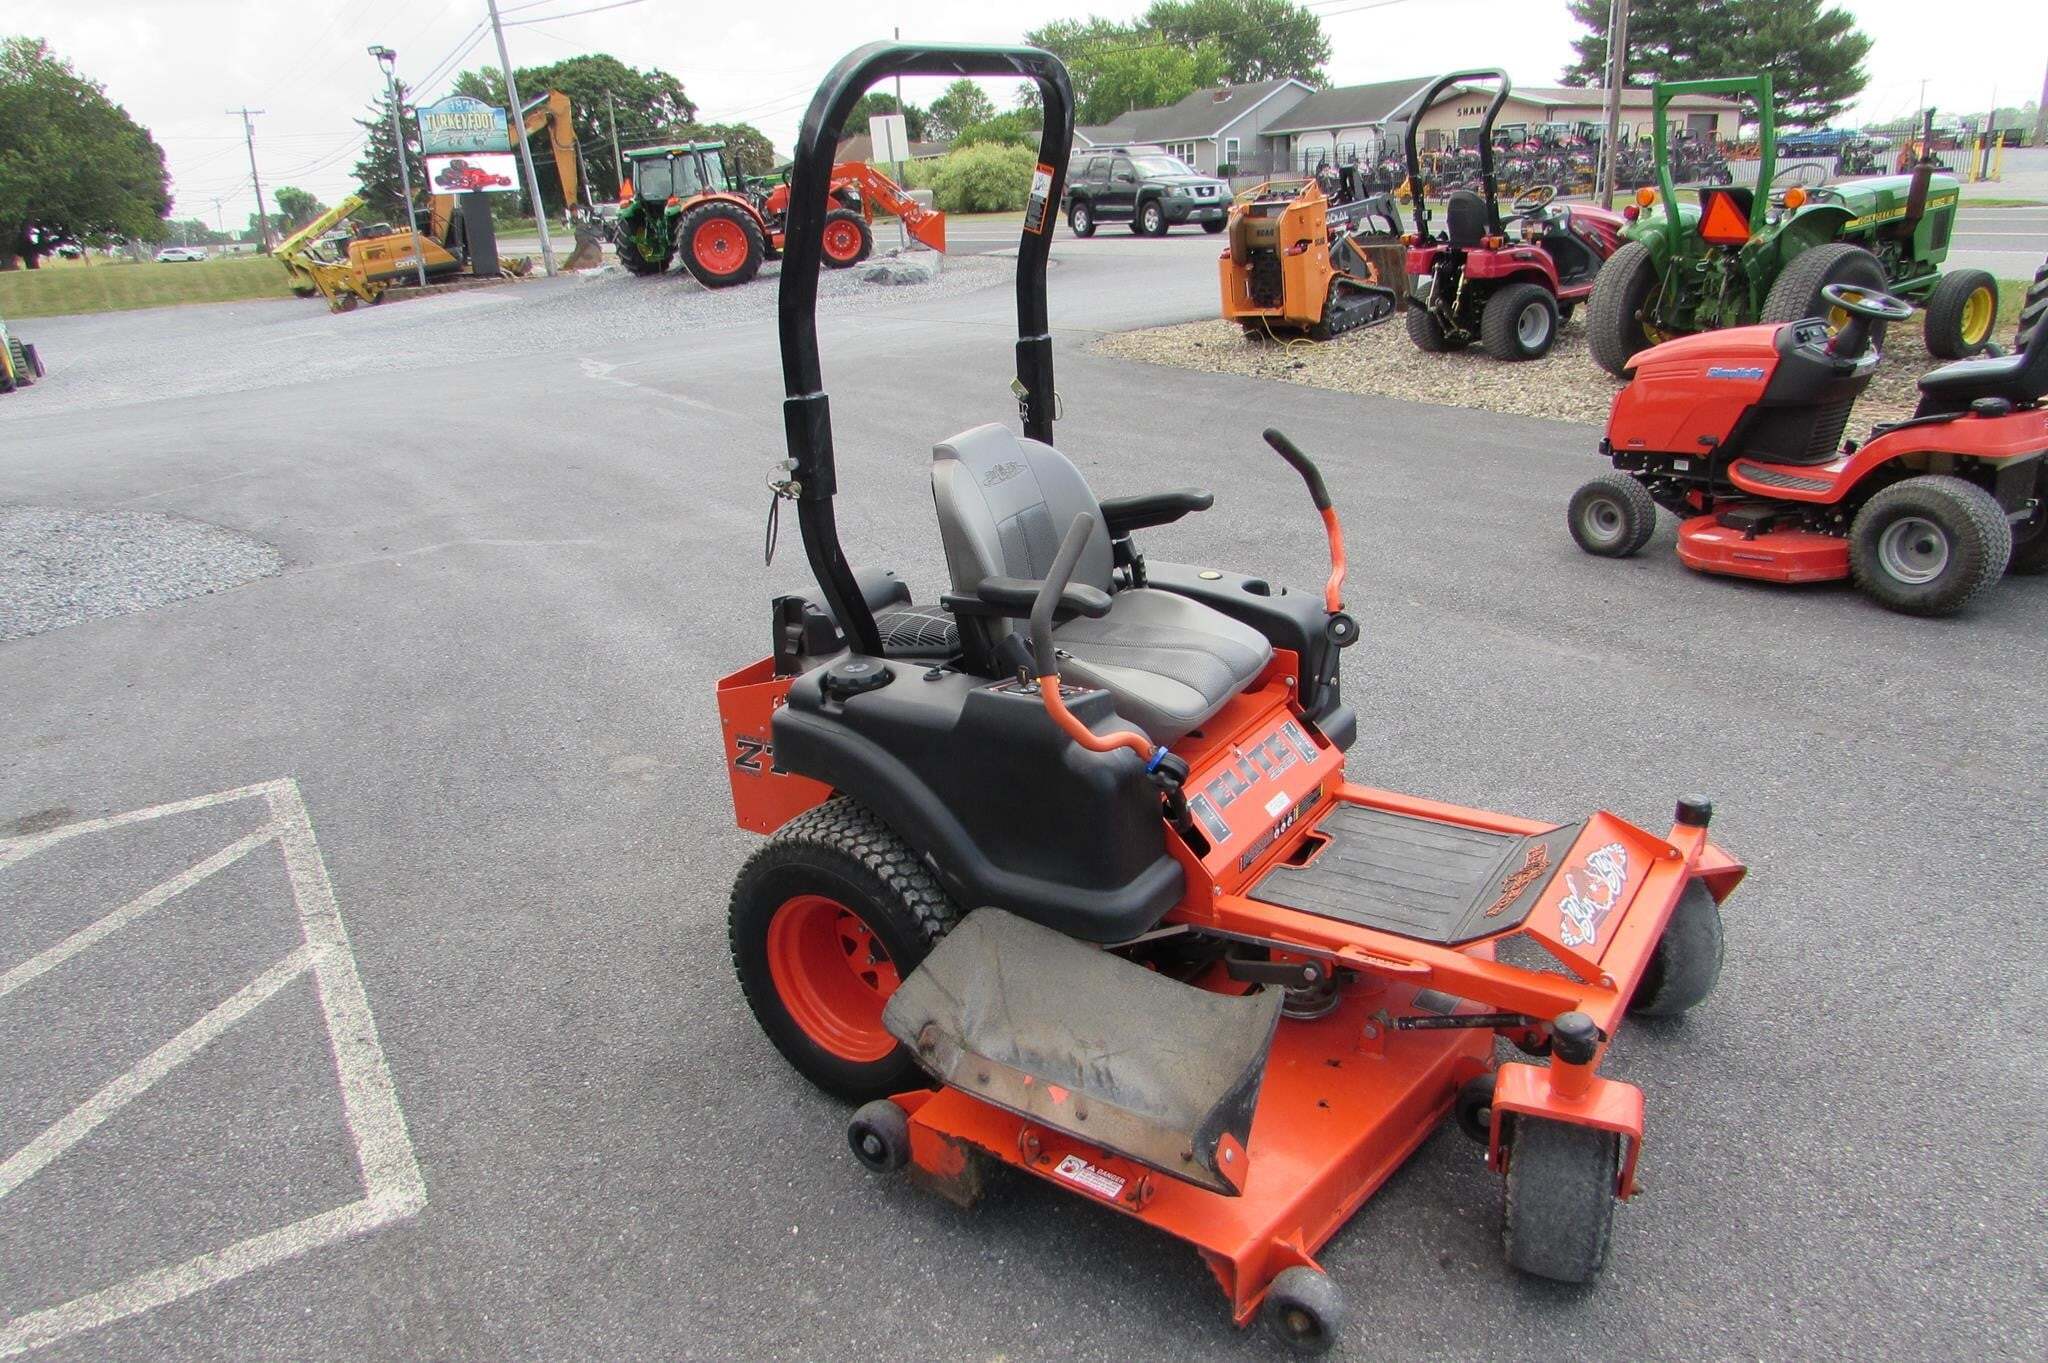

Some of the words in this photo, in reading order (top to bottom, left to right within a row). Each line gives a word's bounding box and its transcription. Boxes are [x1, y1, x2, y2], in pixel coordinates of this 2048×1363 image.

[425, 113, 497, 131] TURKEYFOOT
[1706, 367, 1764, 381] Simplicity
[1205, 732, 1290, 809] ELITE
[1096, 1168, 1126, 1185] DANGER
